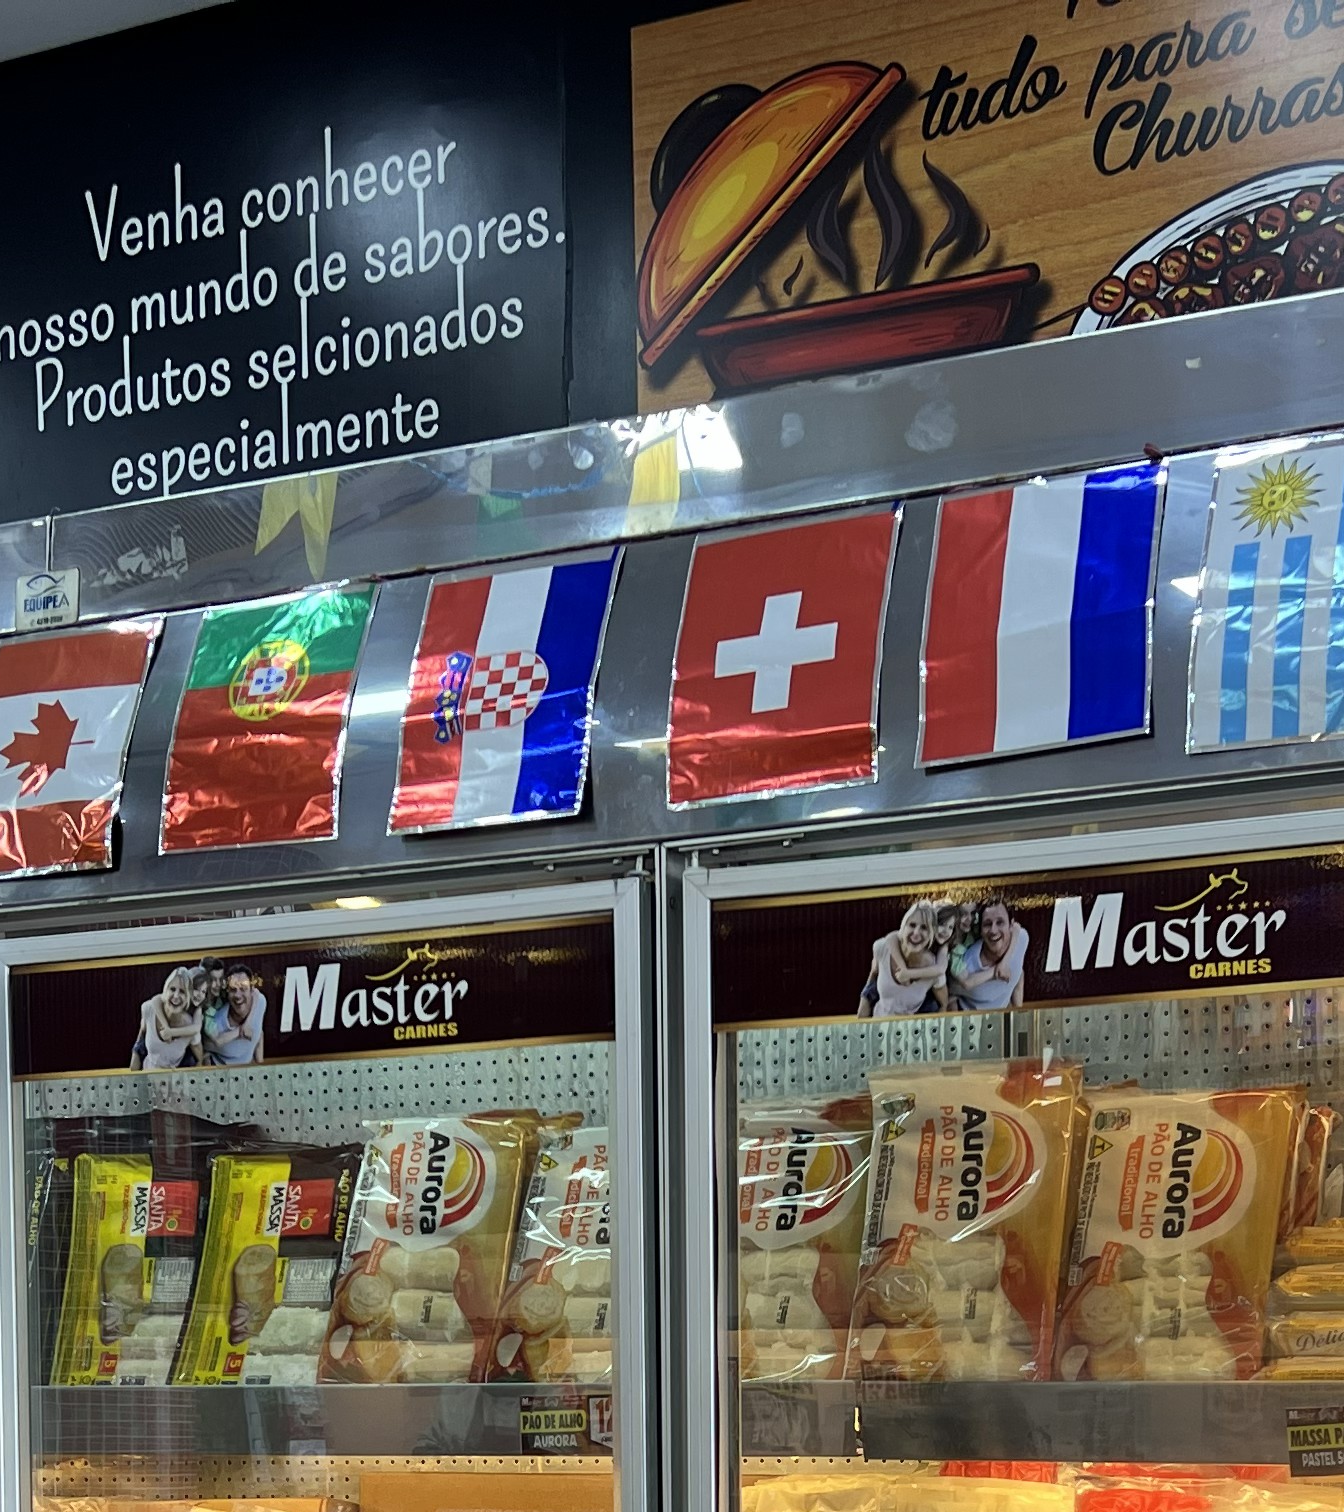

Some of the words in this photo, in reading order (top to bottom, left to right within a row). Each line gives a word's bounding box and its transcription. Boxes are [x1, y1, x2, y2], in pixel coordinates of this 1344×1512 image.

[920, 35, 1067, 141] tudo
[1084, 10, 1256, 118] para
[85, 163, 224, 260] Venha
[242, 126, 456, 228] conhecer
[132, 229, 277, 337] mundo
[295, 214, 346, 299] de
[363, 188, 566, 283] sabores.
[36, 336, 229, 432] Produtos
[248, 263, 524, 392] selcionados
[111, 381, 439, 496] especialmente
[1045, 892, 1287, 972] Master
[1189, 958, 1272, 979] CARNES
[279, 963, 469, 1033] Master
[394, 1023, 457, 1040] CARNES
[937, 1104, 955, 1141] PÃO
[1153, 1122, 1171, 1157] PÃO
[409, 1131, 424, 1163] PÃO
[915, 1130, 932, 1199] tradicional
[937, 1146, 952, 1171] DE
[956, 1104, 987, 1222] Aurora
[405, 1166, 420, 1187] DE
[419, 1131, 450, 1235] Aurora
[1146, 1162, 1164, 1186] DE
[1161, 1121, 1201, 1239] Aurora
[131, 1186, 148, 1234] MASSA
[147, 1186, 165, 1232] SANTA
[266, 1186, 286, 1232] MASSA
[281, 1184, 302, 1232] SANTA
[401, 1194, 415, 1237] ALHO
[934, 1174, 951, 1223] ALHO
[1138, 1189, 1158, 1240] ALHO
[534, 1435, 577, 1448] AURORA
[545, 1415, 556, 1428] DE
[558, 1413, 583, 1428] ALHO
[1290, 1428, 1331, 1447] MASSA
[1302, 1453, 1335, 1467] PASTEL
